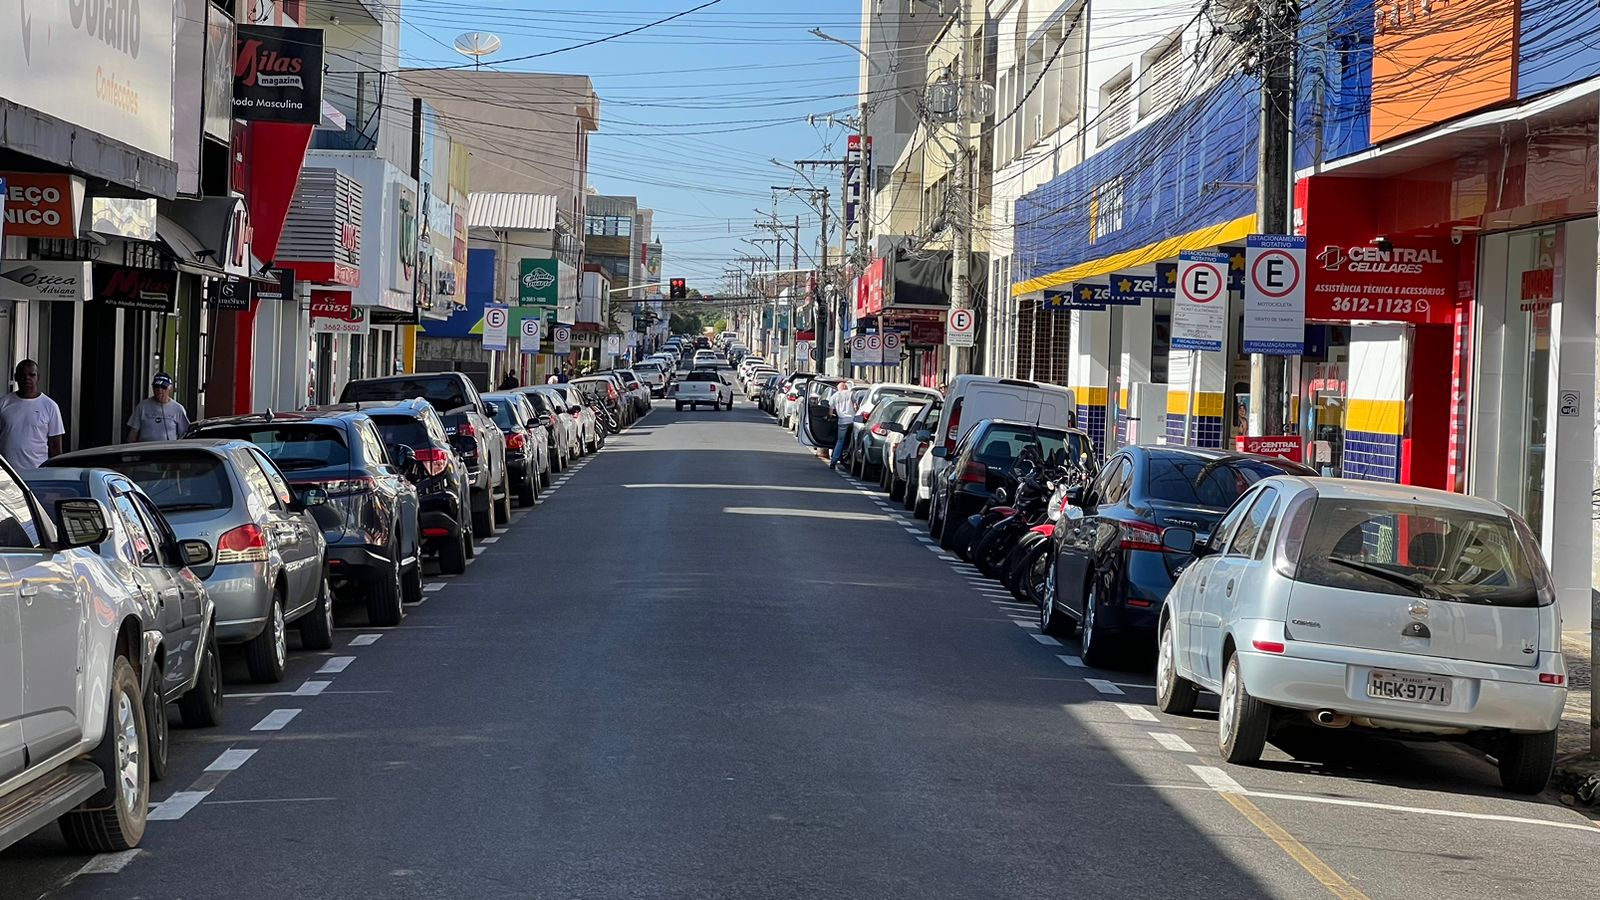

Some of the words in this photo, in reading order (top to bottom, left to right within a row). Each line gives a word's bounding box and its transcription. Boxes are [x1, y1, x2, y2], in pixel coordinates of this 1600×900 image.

[261, 76, 300, 85] magazine
[256, 98, 303, 109] Masculina
[5, 186, 60, 206] EÇO
[1248, 235, 1305, 243] ESTACIONAMENTO
[1181, 250, 1229, 259] ESTACIONAMENTO
[1348, 246, 1444, 263] CENTRAL
[1267, 259, 1284, 287] E
[1348, 263, 1423, 274] CELULARES
[20, 268, 77, 285] Ótica
[1193, 271, 1209, 294] E
[37, 285, 76, 294] Adriana
[1315, 283, 1361, 293] ASSISTÊNCIA
[1363, 284, 1393, 294] TÉCNICA
[1401, 286, 1446, 296] ACESSÓRIOS
[1331, 297, 1412, 313] 3612-1123
[492, 313, 499, 324] E
[957, 314, 964, 326] E
[527, 324, 534, 334] E
[559, 331, 565, 339] E
[888, 336, 893, 345] E
[857, 340, 862, 348] E
[871, 338, 877, 347] E
[1373, 679, 1445, 702] HGK-9771
